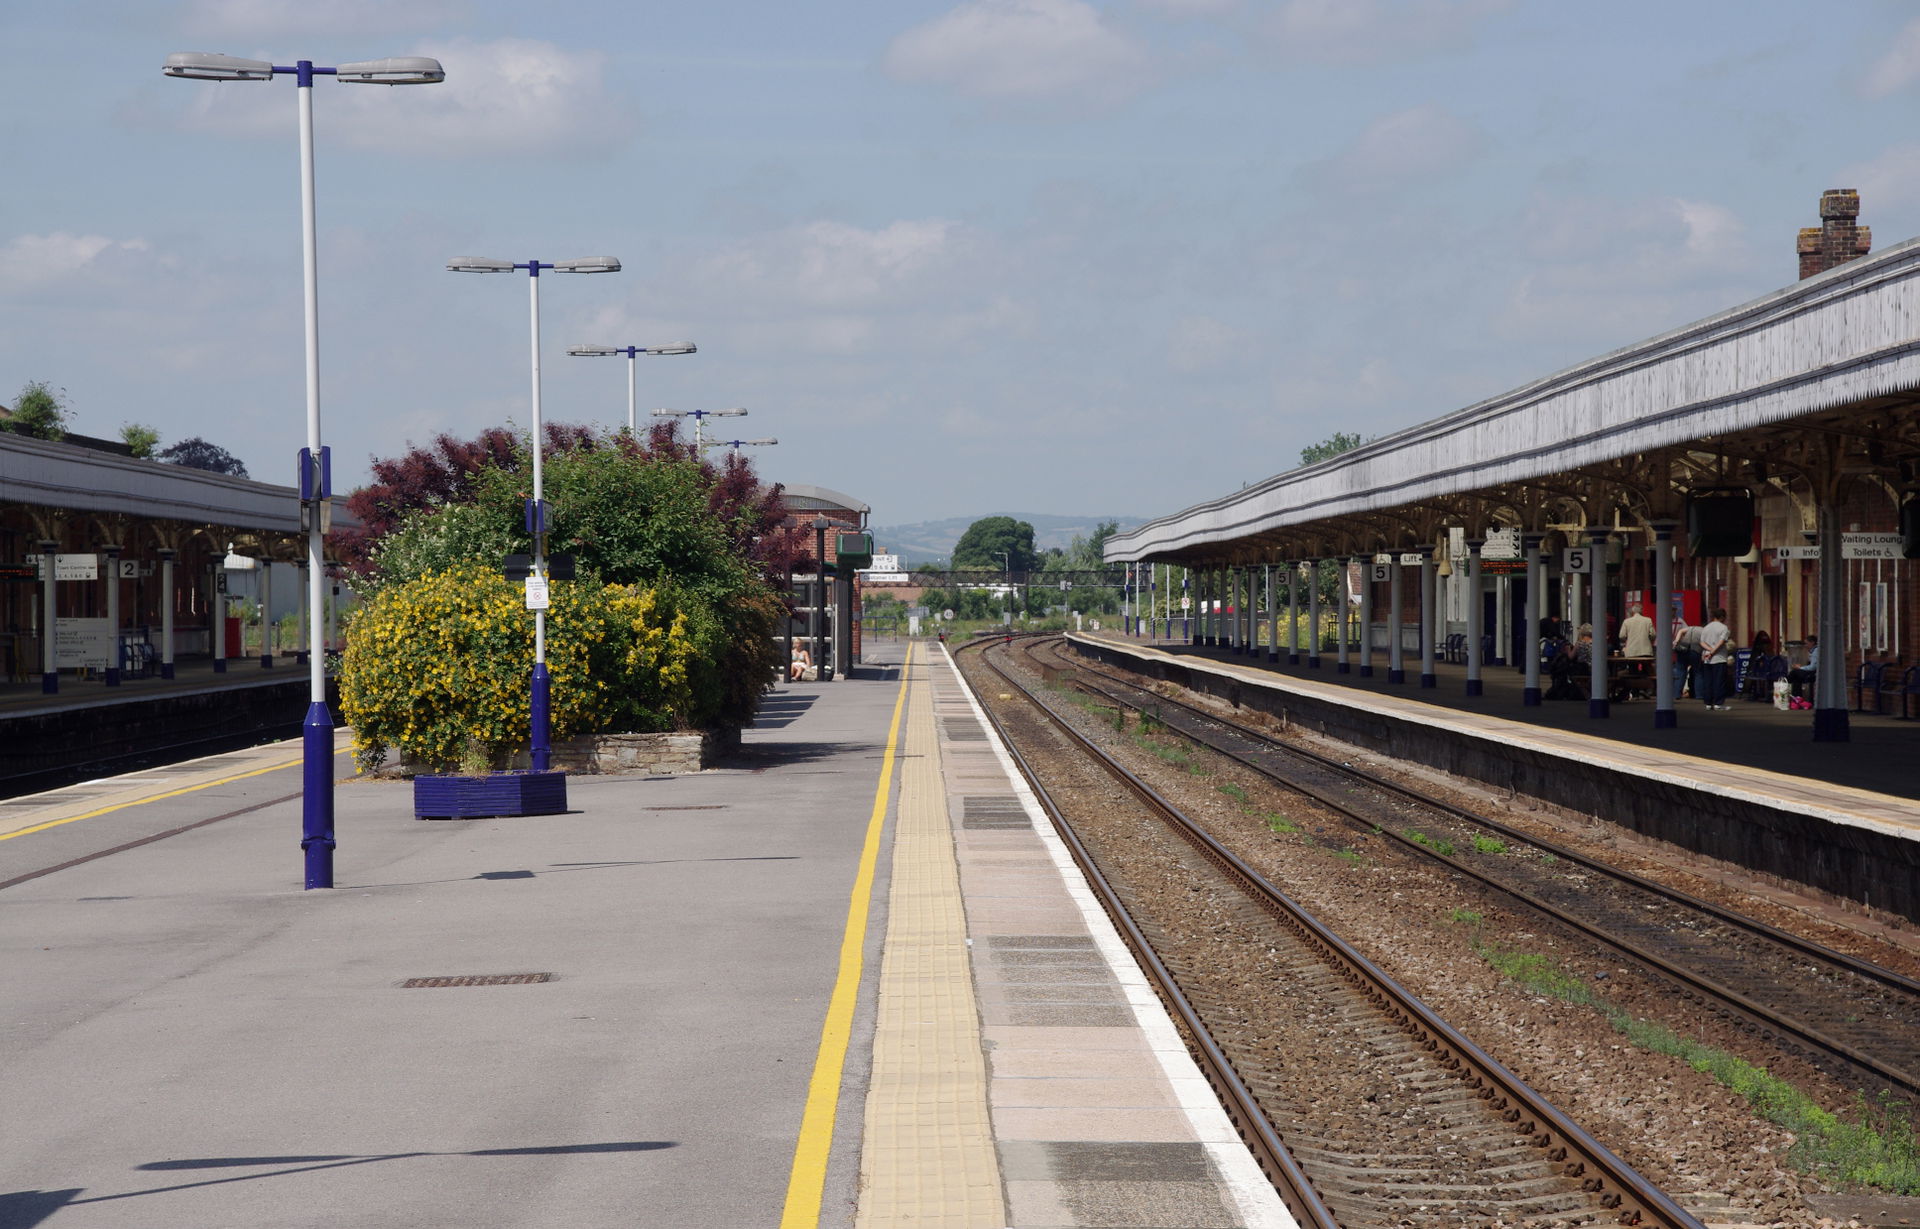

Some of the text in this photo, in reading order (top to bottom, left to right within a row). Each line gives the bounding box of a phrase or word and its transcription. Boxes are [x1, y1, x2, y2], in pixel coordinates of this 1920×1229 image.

[1874, 535, 1902, 544] Loung
[1853, 548, 1881, 556] Toilets
[1571, 552, 1583, 568] 5
[125, 562, 134, 575] 2
[1376, 566, 1385, 579] 5
[1279, 572, 1287, 583] 5
